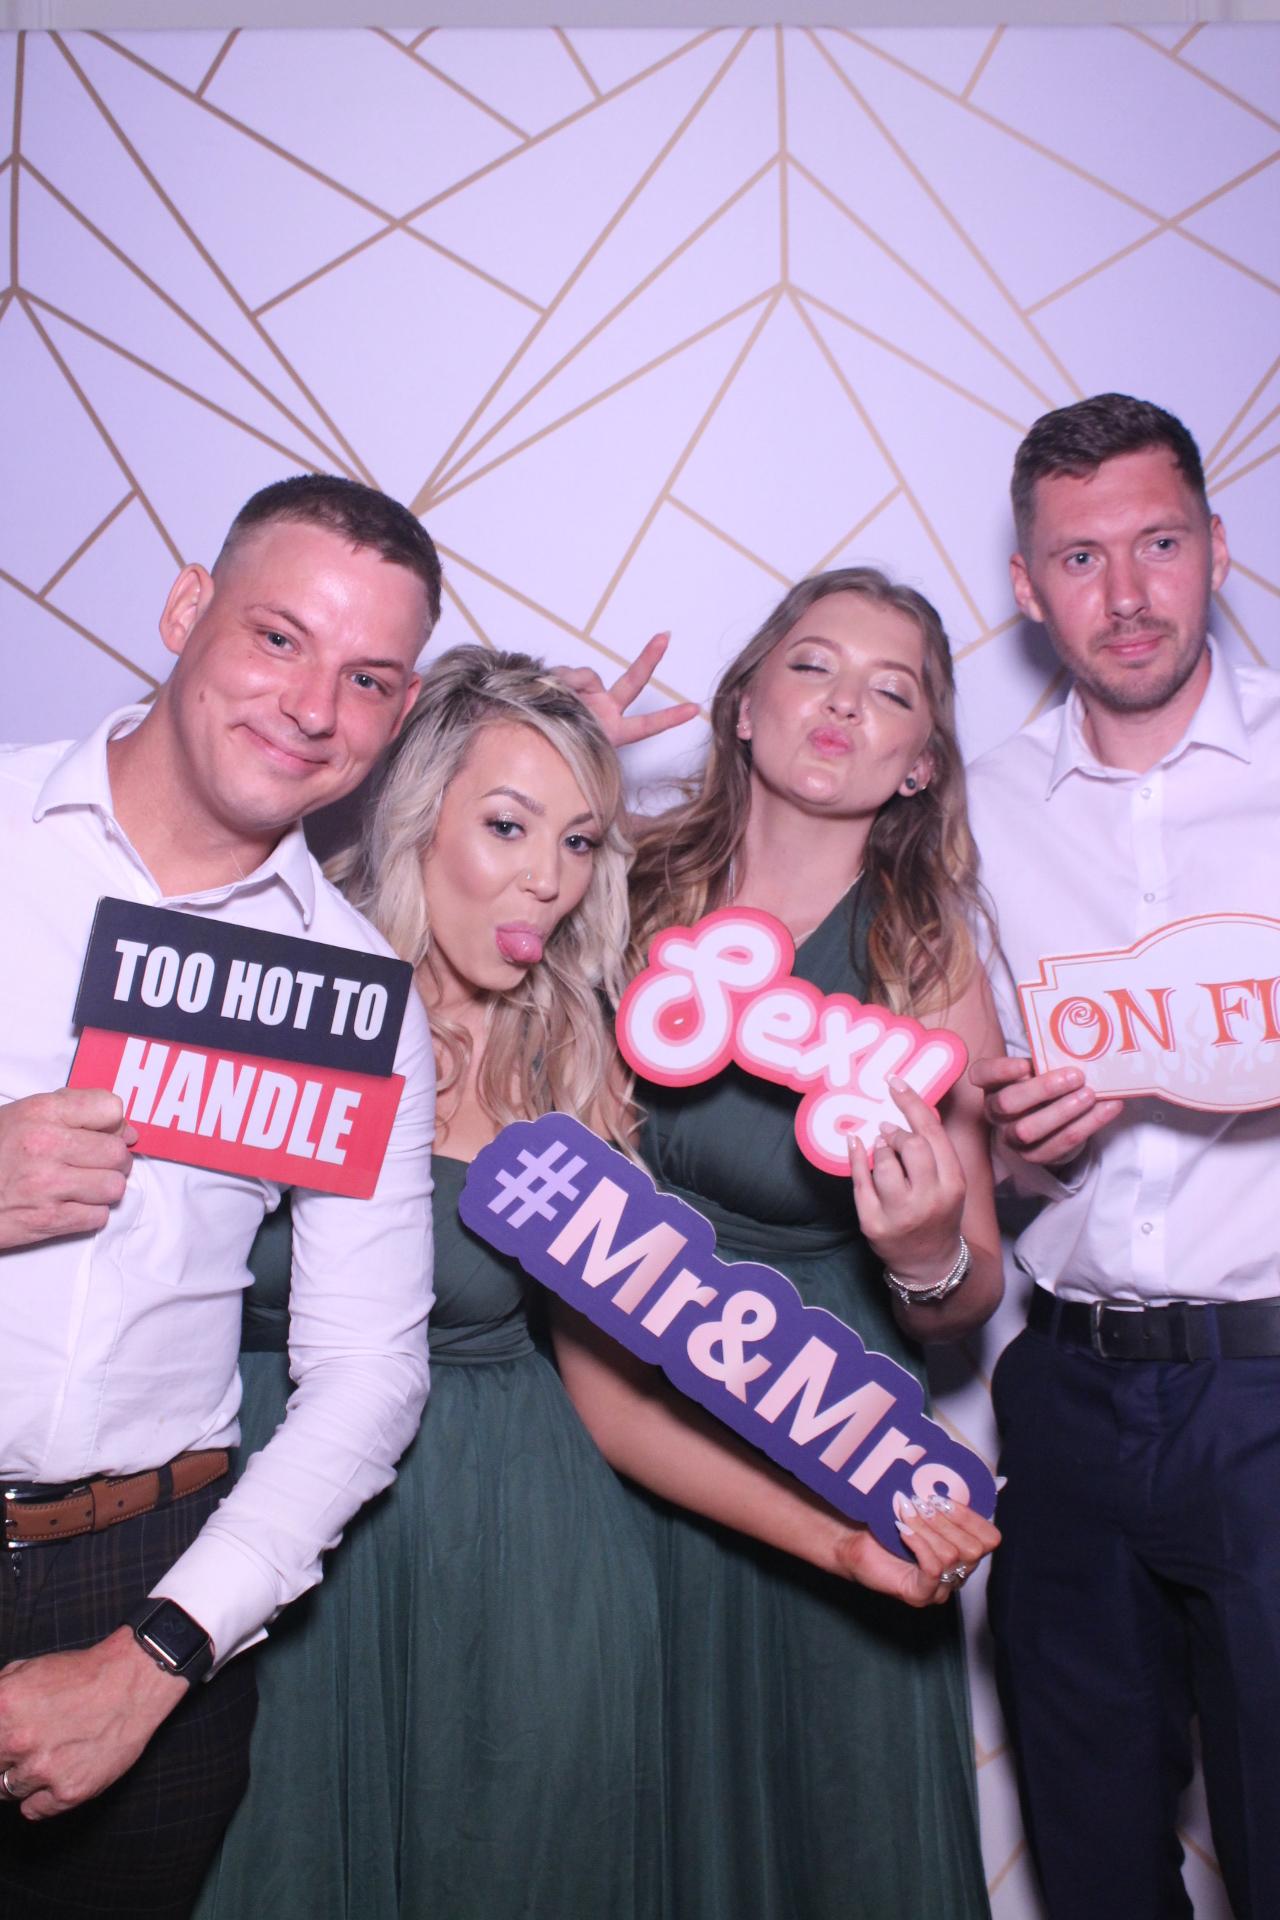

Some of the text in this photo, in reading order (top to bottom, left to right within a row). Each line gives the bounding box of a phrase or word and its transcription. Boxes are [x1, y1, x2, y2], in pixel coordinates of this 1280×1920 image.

[113, 938, 389, 1041] TOO HOT TO
[626, 919, 954, 1163] Sexy
[1049, 987, 1175, 1062] ON
[112, 1036, 362, 1166] HANDLE
